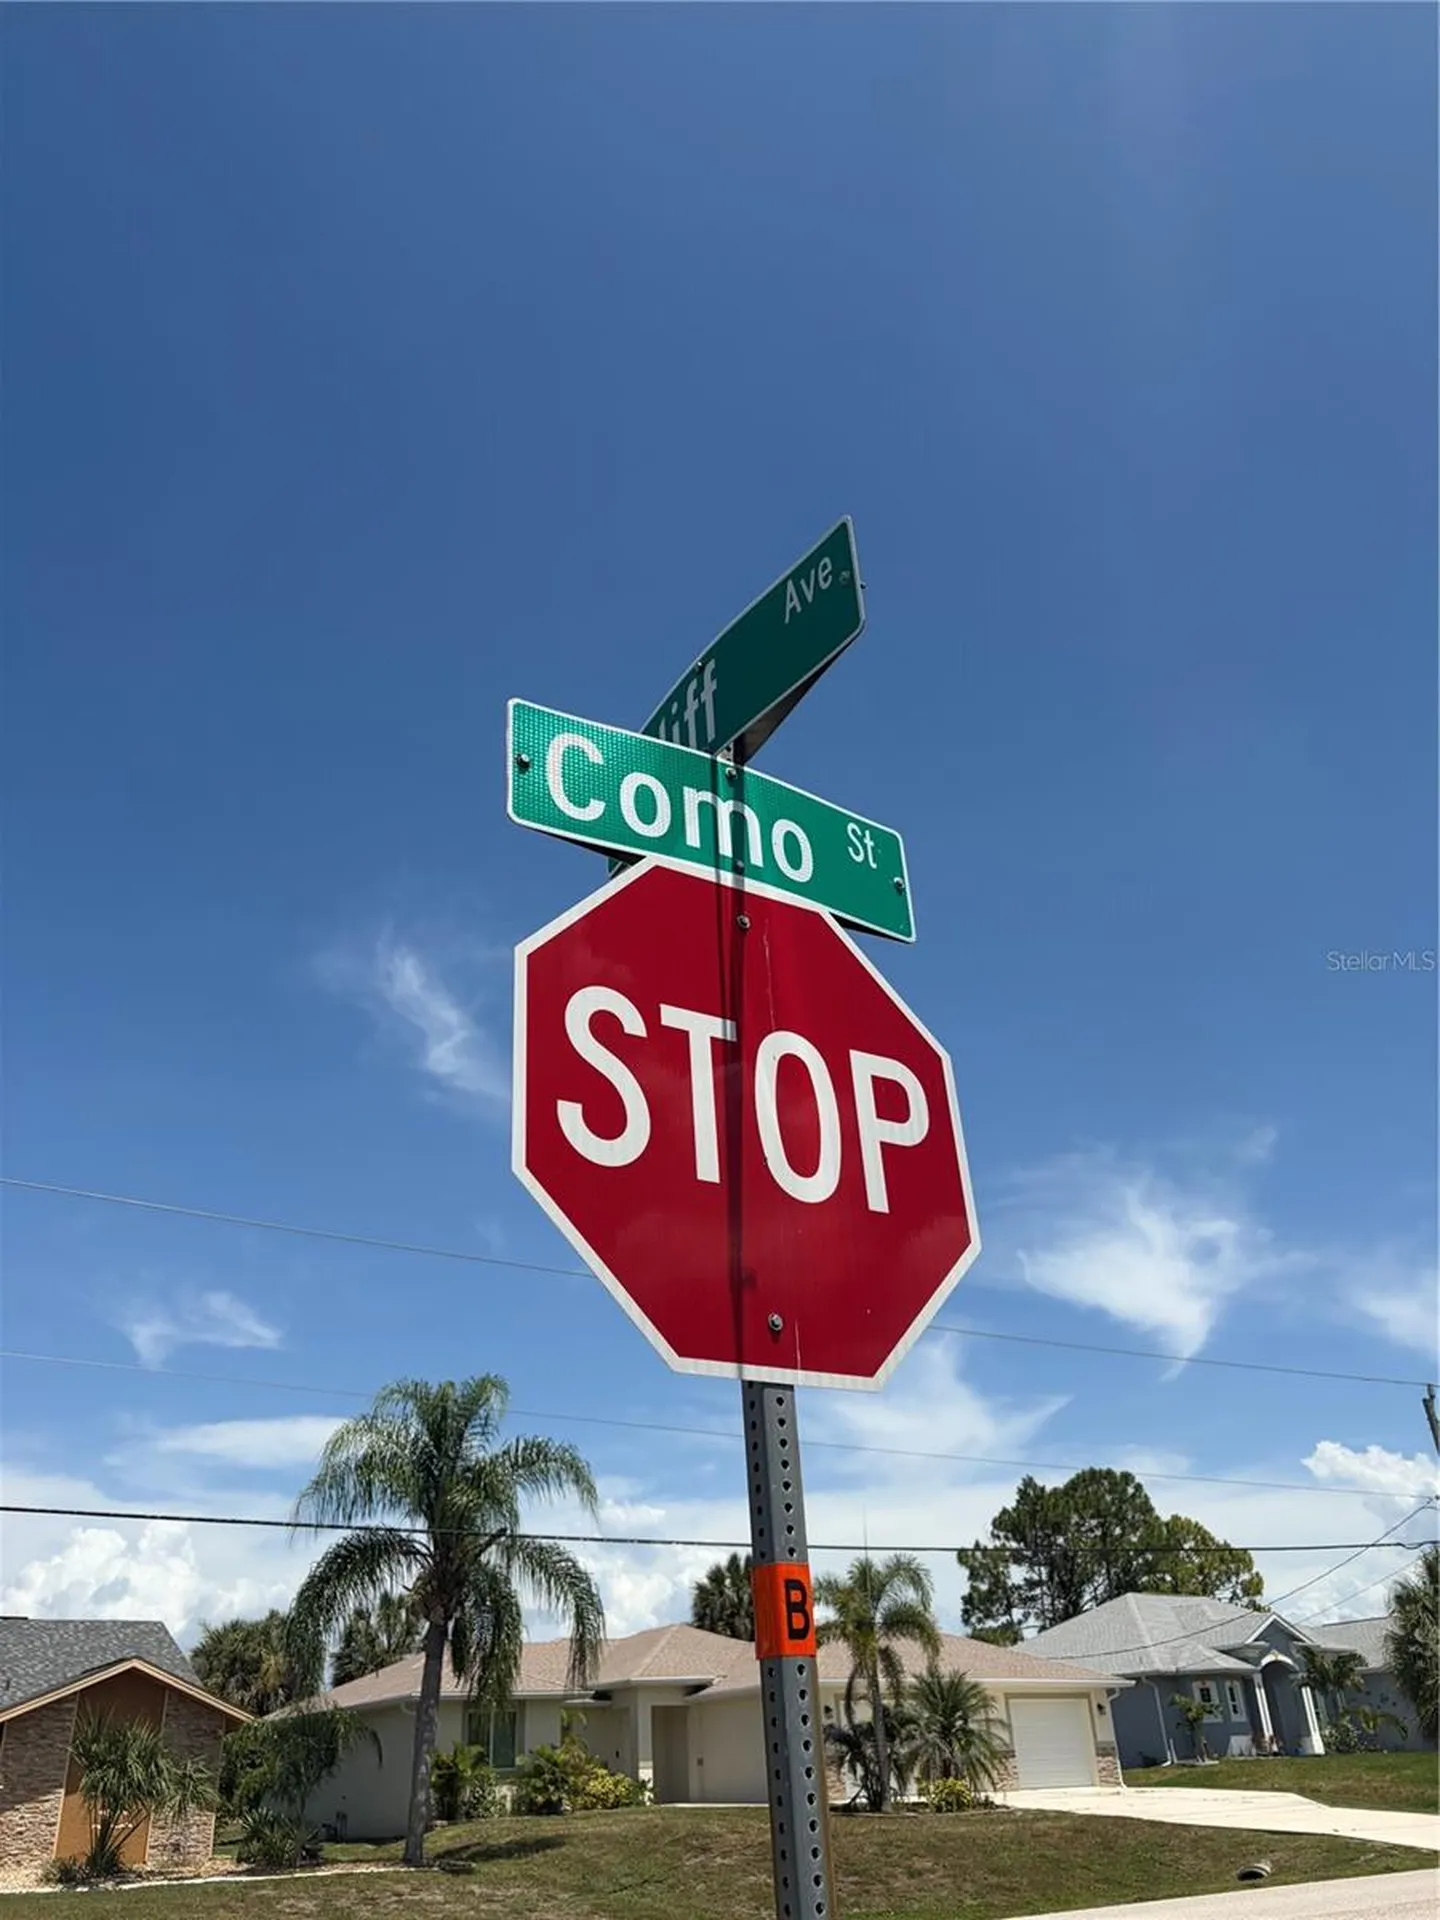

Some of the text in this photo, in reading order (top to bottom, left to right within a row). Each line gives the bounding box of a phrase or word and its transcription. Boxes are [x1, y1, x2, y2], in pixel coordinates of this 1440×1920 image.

[784, 557, 833, 624] Ave
[547, 734, 878, 883] Como St
[557, 985, 930, 1214] STOP
[785, 1579, 810, 1639] B
